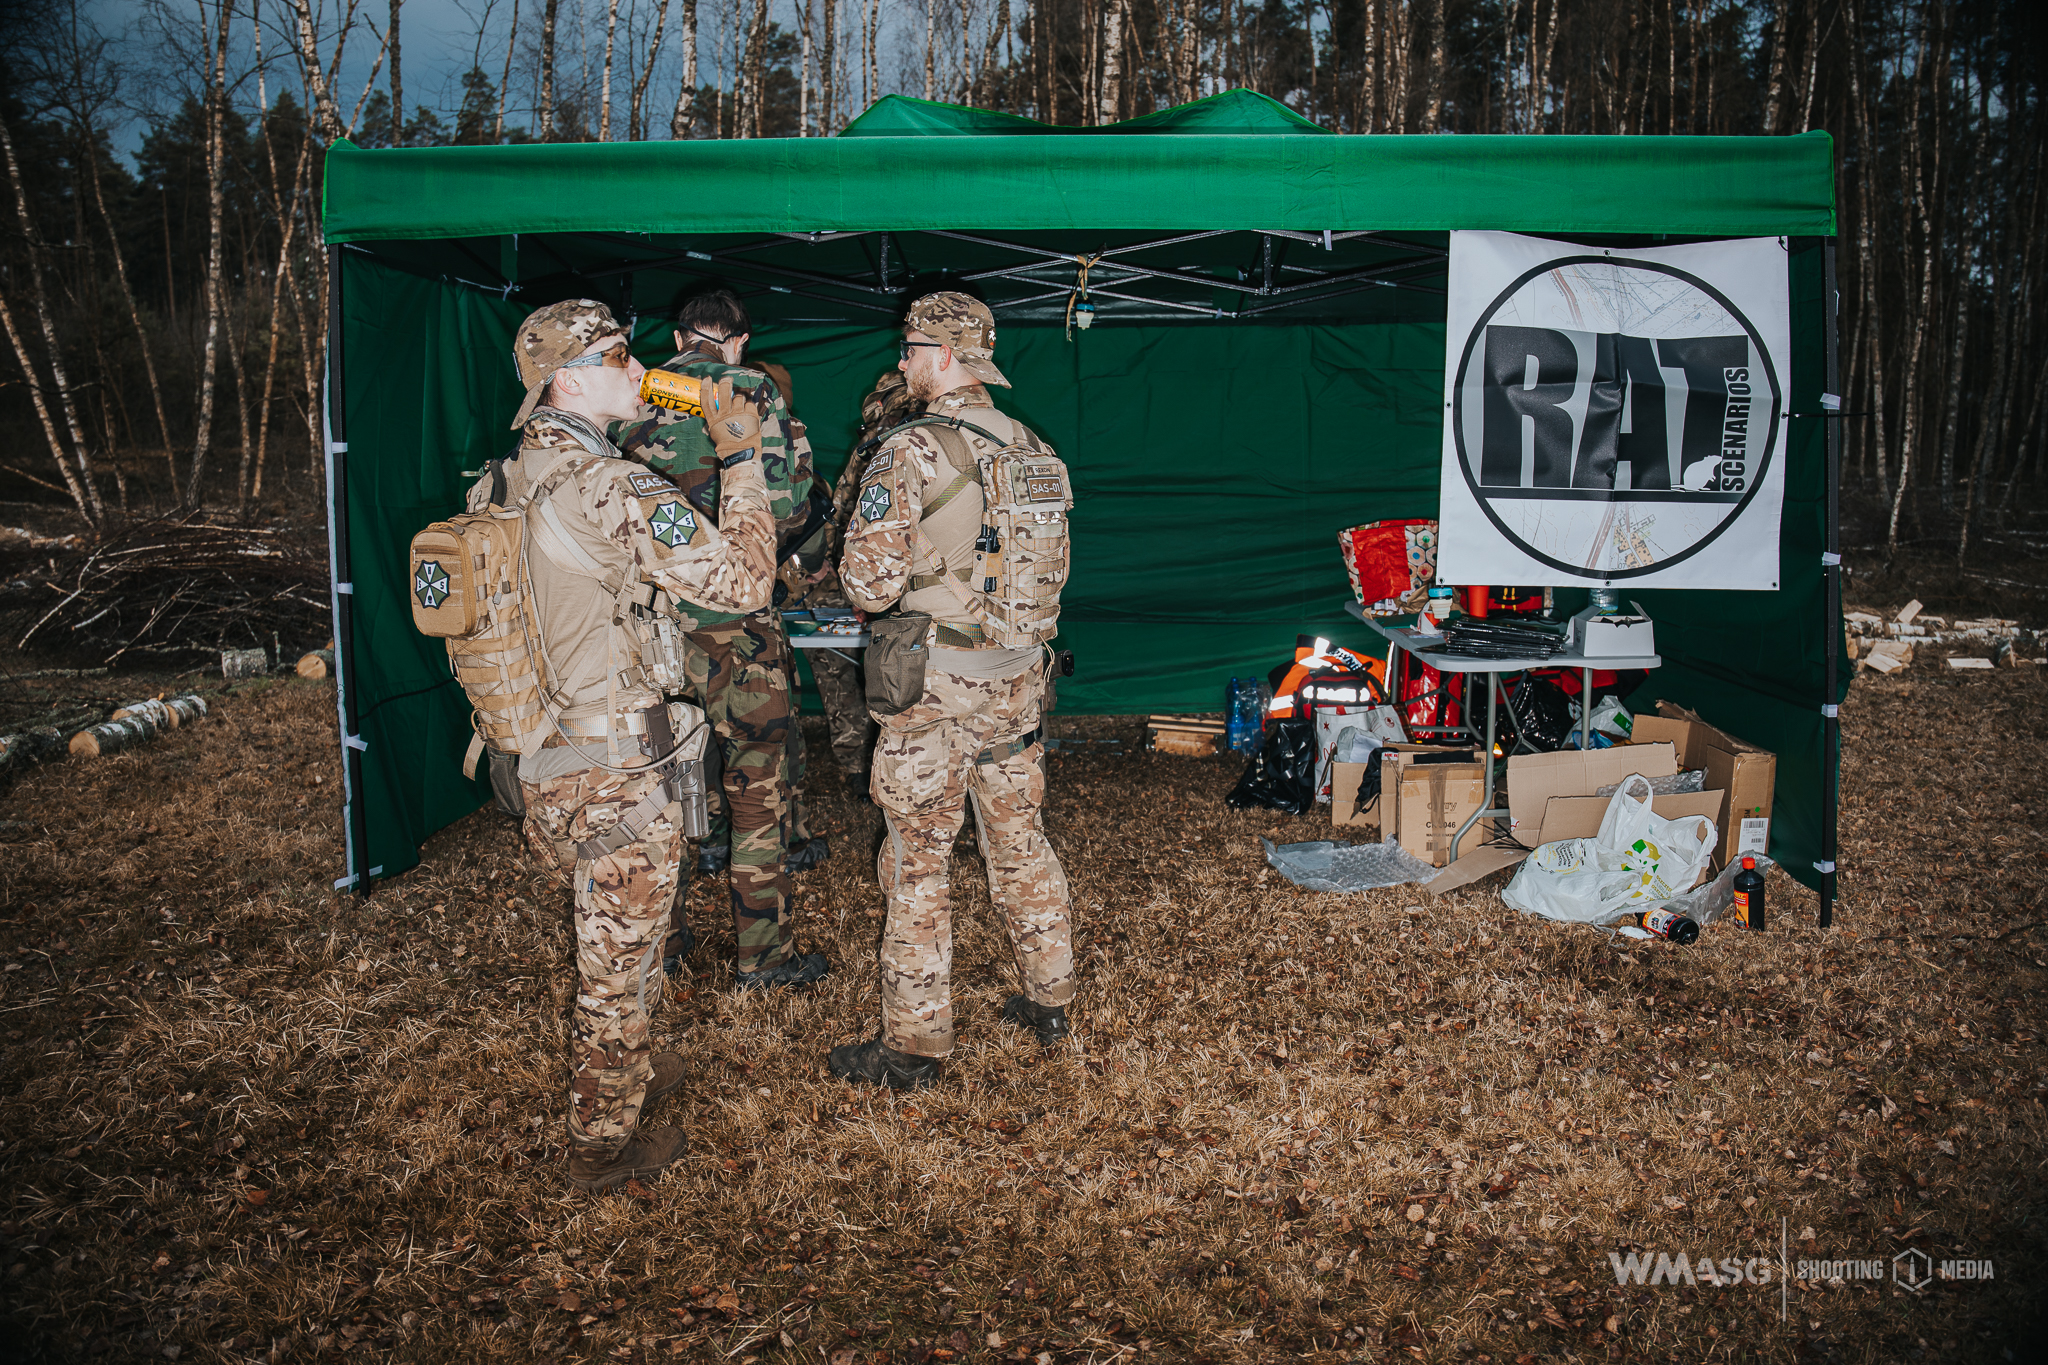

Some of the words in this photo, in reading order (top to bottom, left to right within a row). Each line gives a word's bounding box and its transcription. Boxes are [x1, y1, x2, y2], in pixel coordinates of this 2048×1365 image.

[651, 387, 680, 399] MANGO
[650, 394, 706, 418] DZIK
[1481, 325, 1748, 491] RAT
[1721, 368, 1752, 491] SCENARIOS
[1031, 482, 1061, 494] SAS-01
